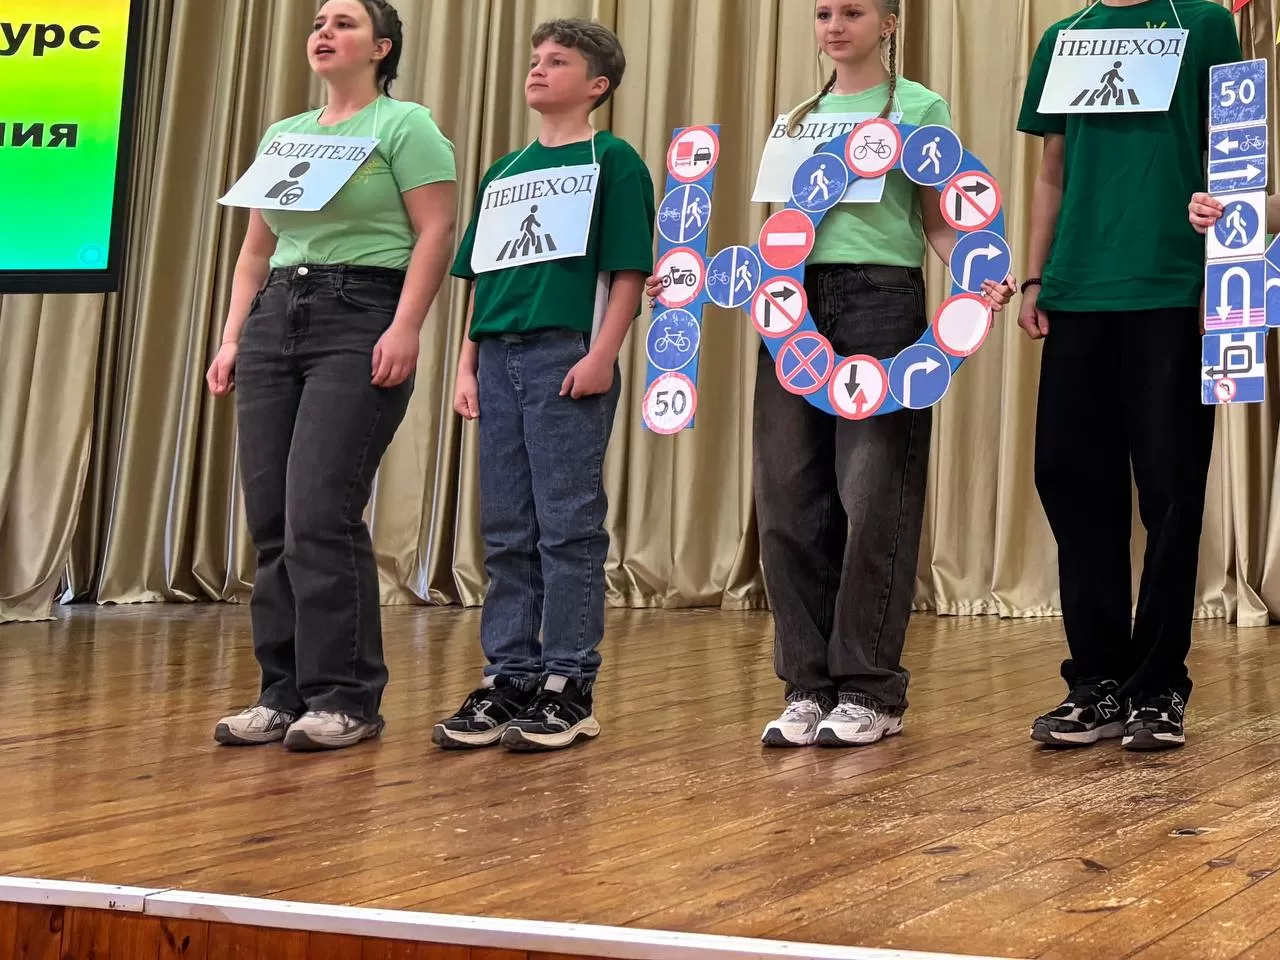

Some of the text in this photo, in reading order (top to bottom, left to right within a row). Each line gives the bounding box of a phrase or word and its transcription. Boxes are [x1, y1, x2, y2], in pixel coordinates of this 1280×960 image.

[0, 22, 101, 57] урс
[1057, 38, 1182, 57] ПЕШЕХОД
[1219, 78, 1256, 108] 50
[771, 122, 860, 141] ВОДИТ
[264, 141, 367, 162] ВОДИТЕЛЬ
[484, 174, 594, 210] ПЕШЕХОД
[654, 389, 687, 417] 50
